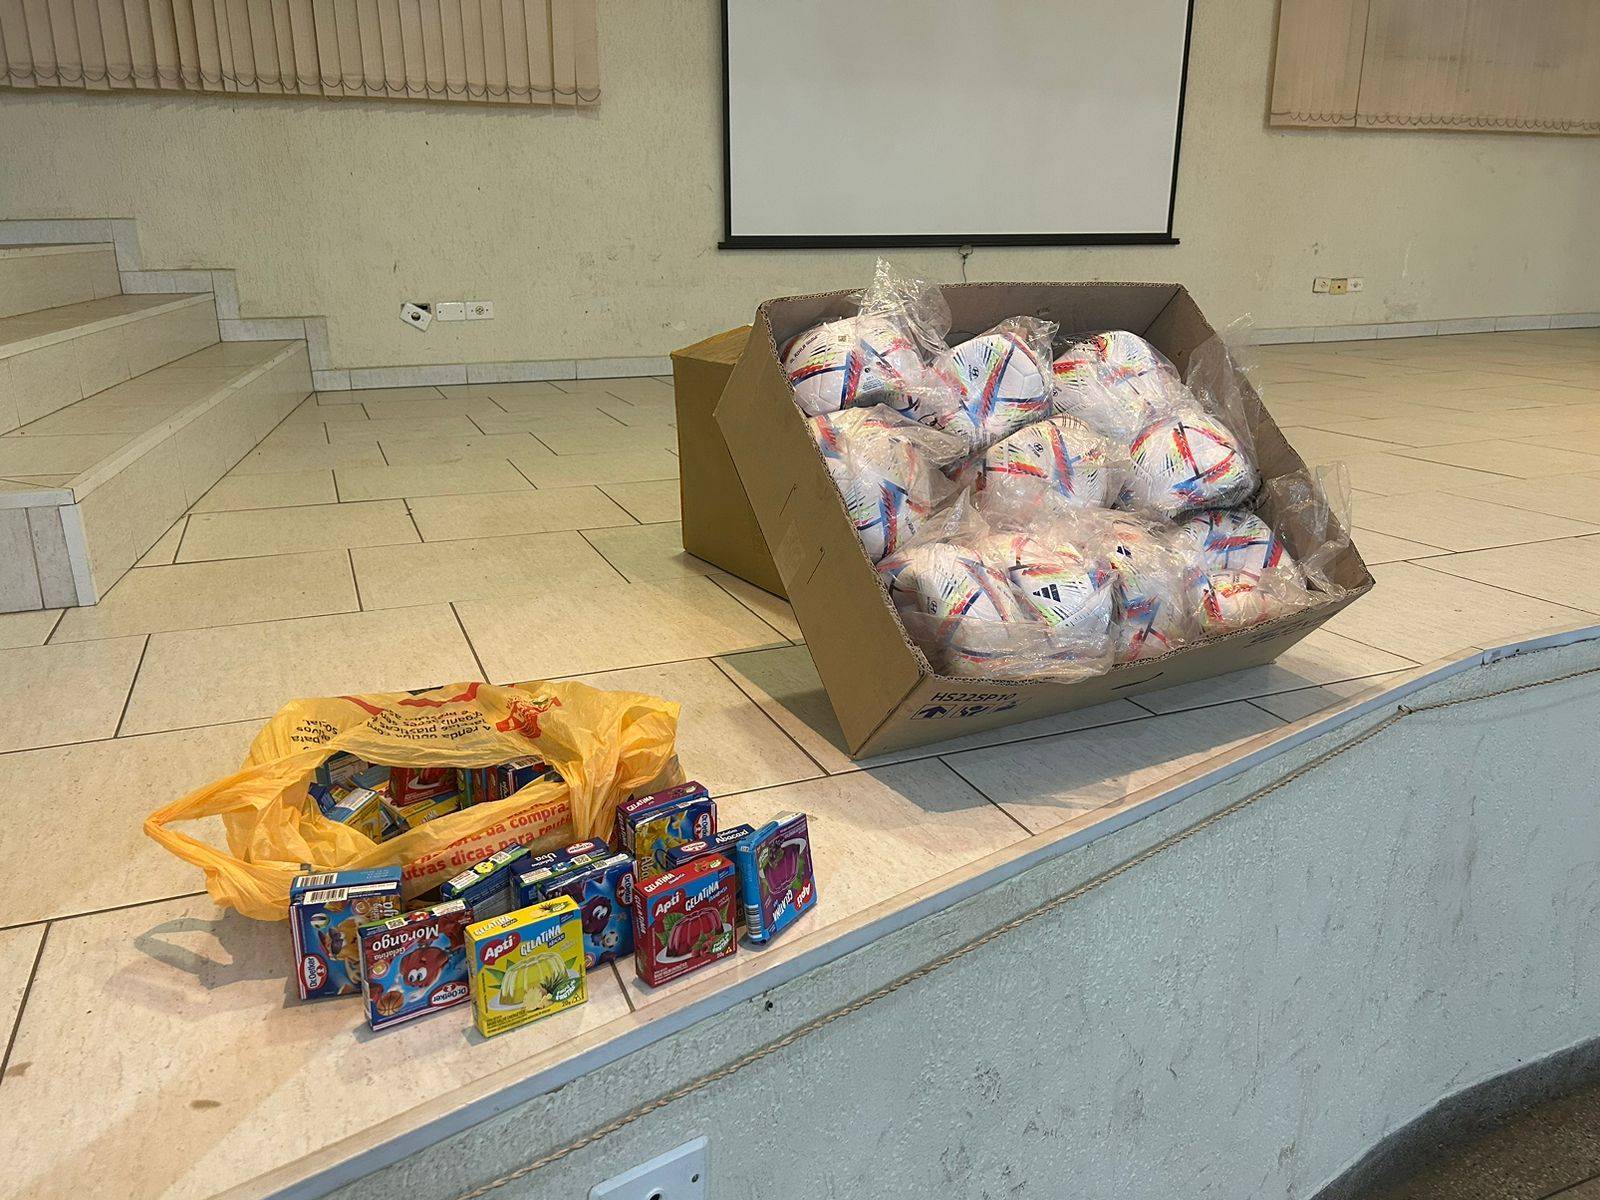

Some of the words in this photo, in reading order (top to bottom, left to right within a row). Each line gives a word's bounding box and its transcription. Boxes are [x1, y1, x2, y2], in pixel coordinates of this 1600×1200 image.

[402, 859, 447, 882] utras
[451, 842, 495, 867] dicas
[534, 852, 558, 862] Uva
[644, 873, 675, 893] GELATINA
[797, 883, 811, 908] Apti
[655, 891, 681, 917] Apti
[372, 924, 440, 951] Morango
[484, 935, 515, 961] Apti
[373, 946, 406, 961] Gelatina
